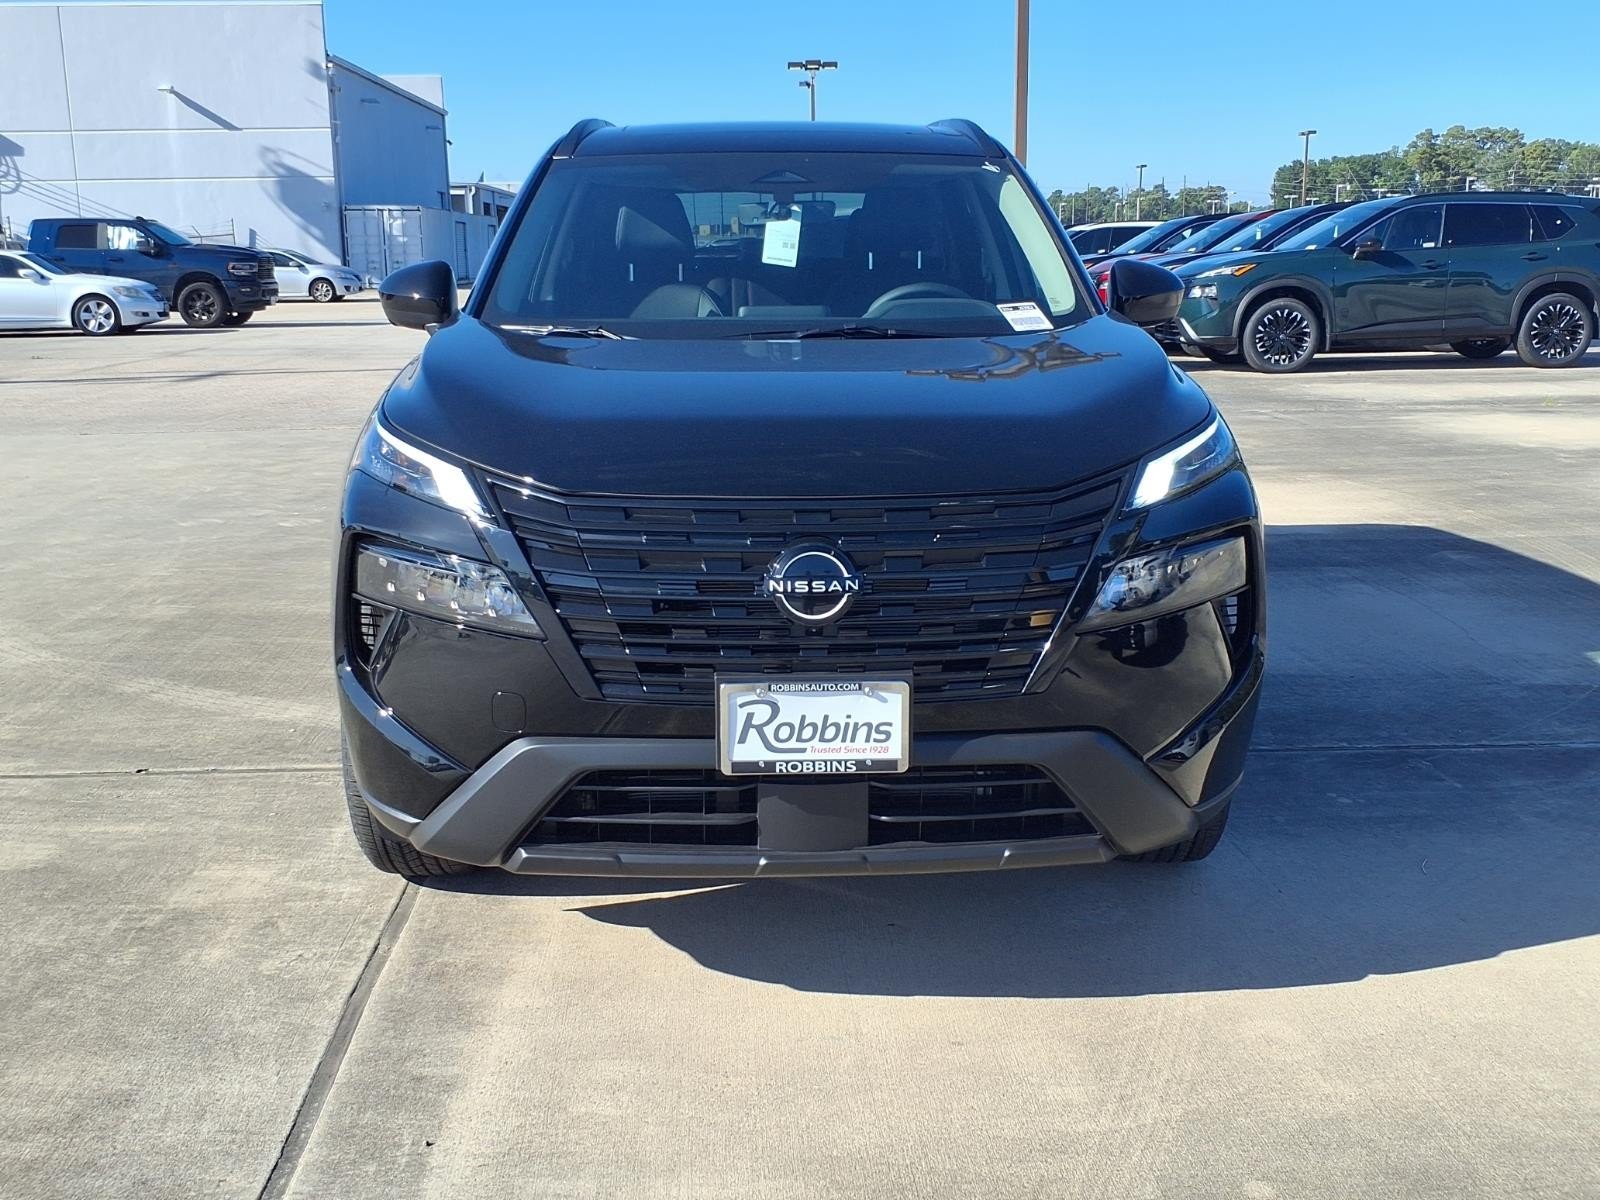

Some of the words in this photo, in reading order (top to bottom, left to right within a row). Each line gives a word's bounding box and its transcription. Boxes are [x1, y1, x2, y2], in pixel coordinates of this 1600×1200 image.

[769, 579, 859, 593] NISSAN
[771, 683, 860, 692] ROBBINSAUTO.COM
[737, 700, 893, 753] Robbins
[810, 745, 842, 753] Trusted
[844, 745, 868, 753] Since
[869, 745, 889, 753] 1928
[775, 760, 857, 773] ROBBINS
